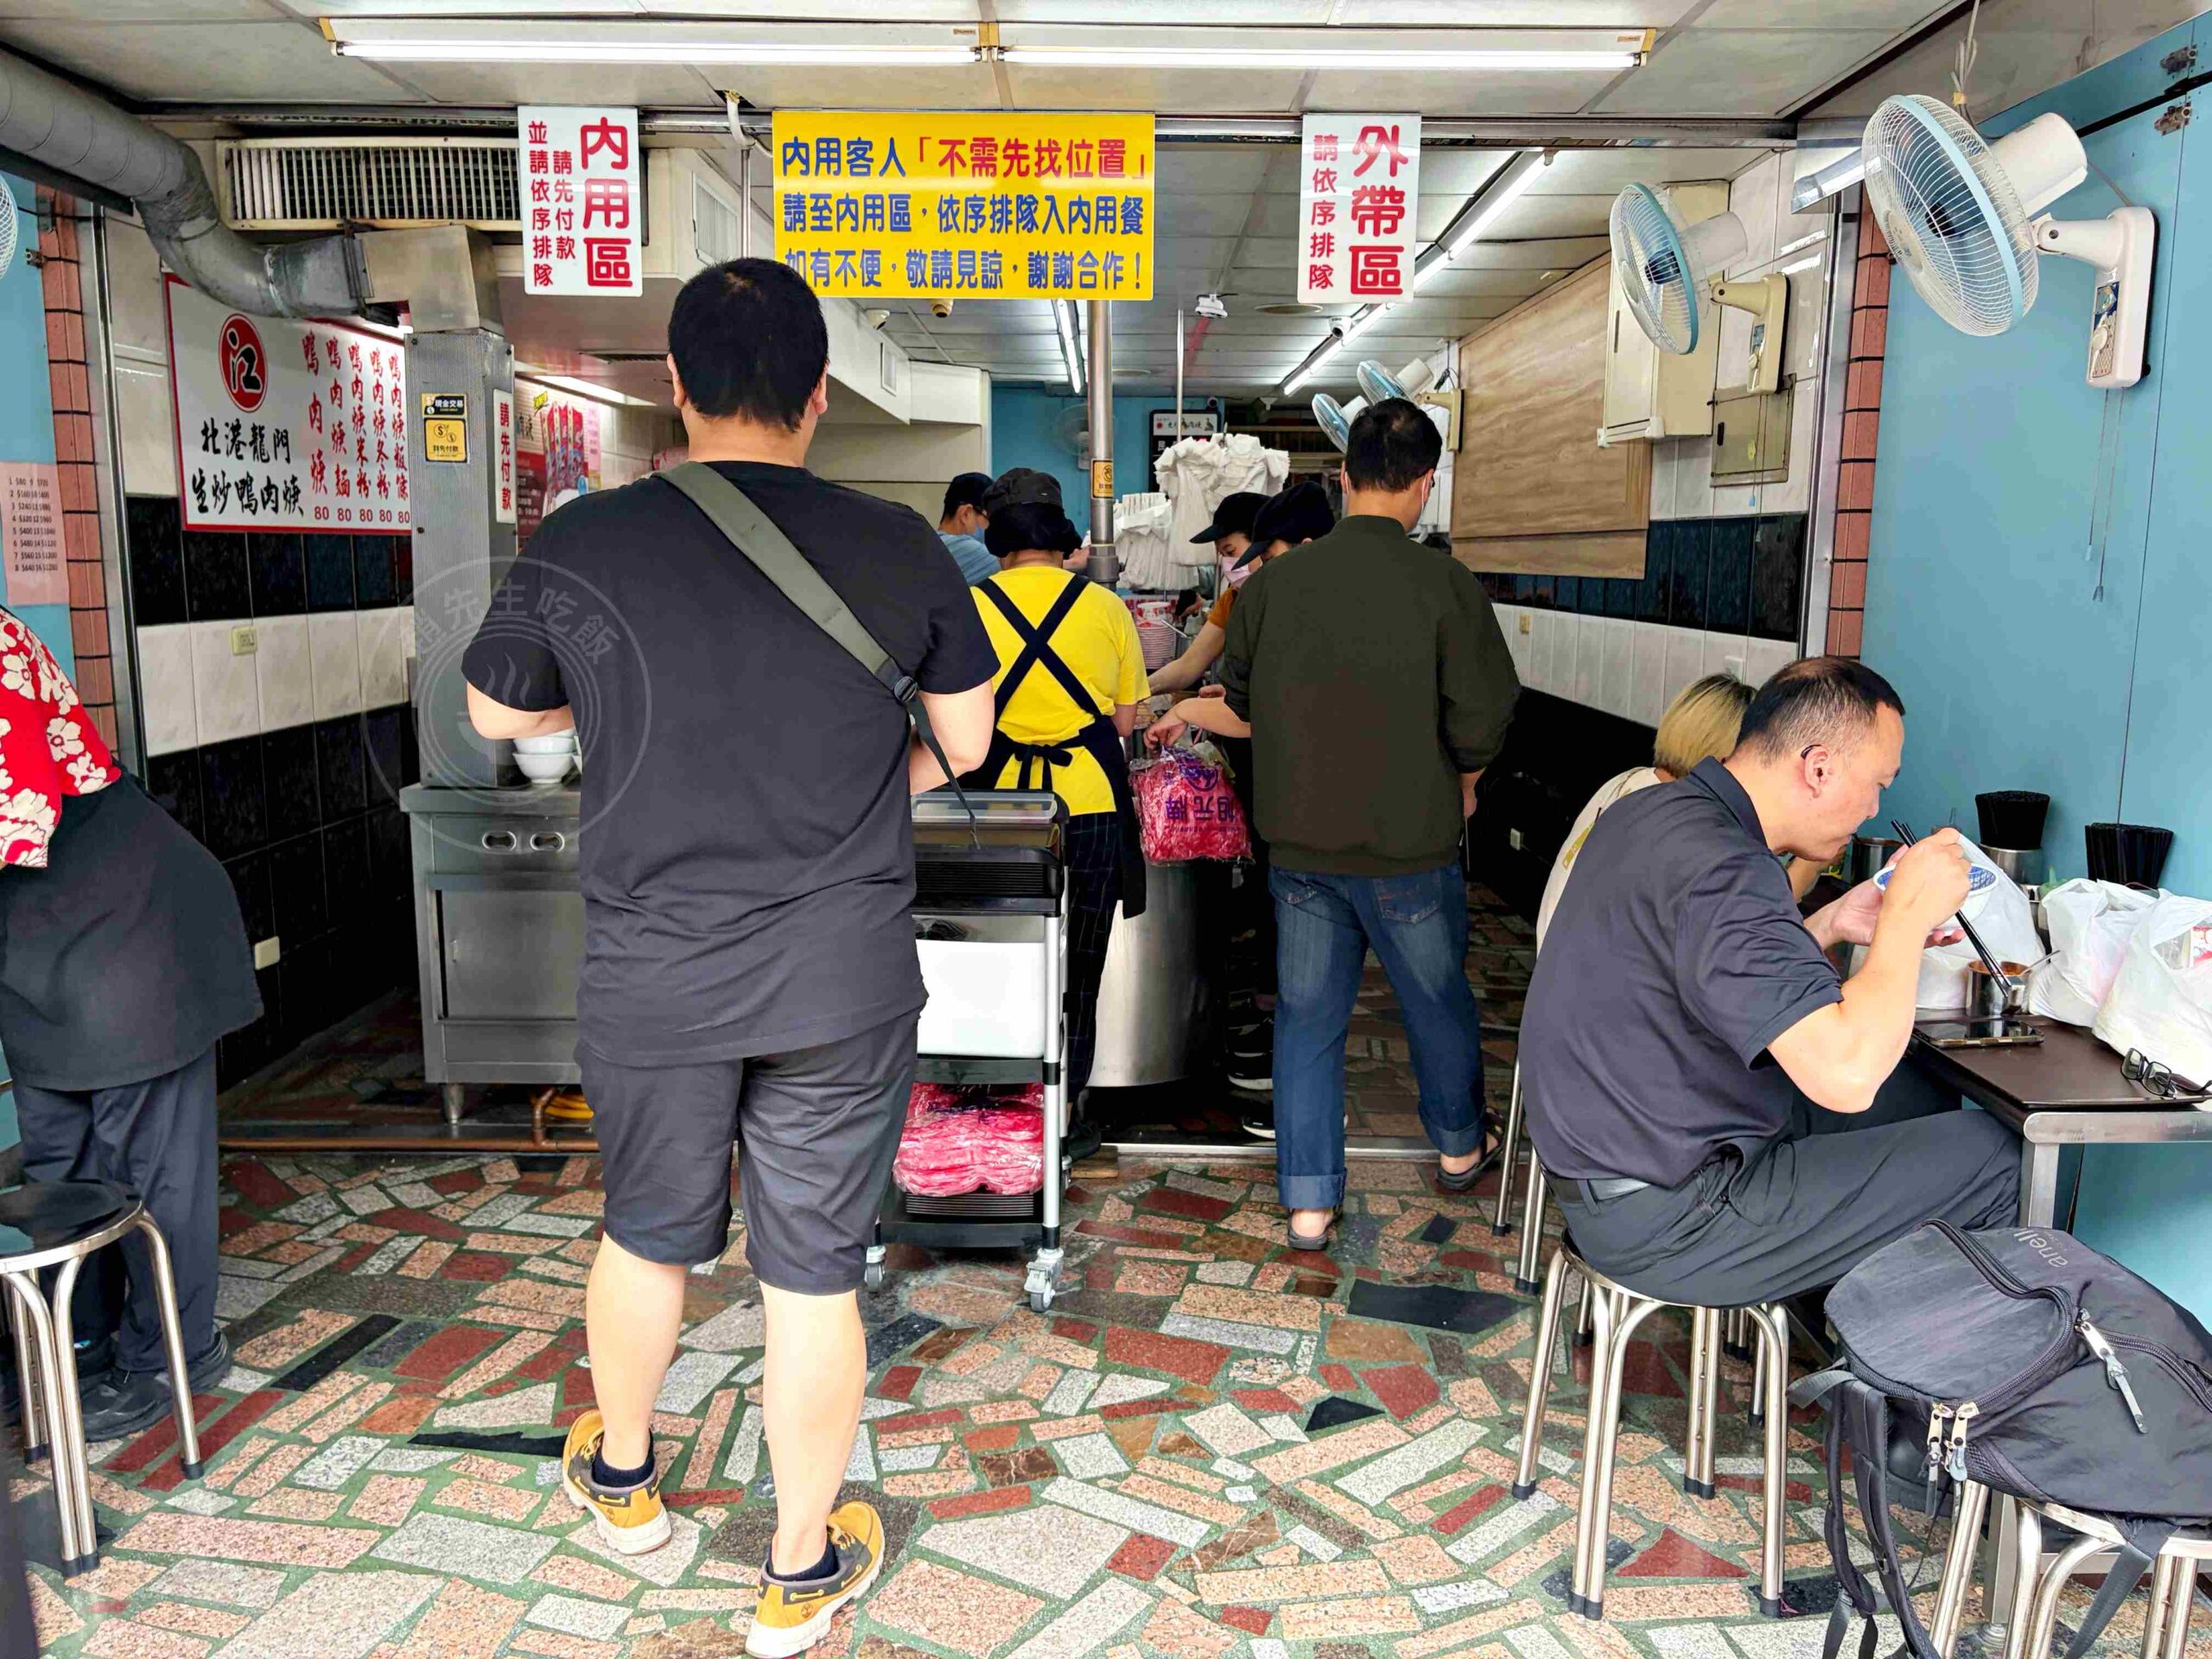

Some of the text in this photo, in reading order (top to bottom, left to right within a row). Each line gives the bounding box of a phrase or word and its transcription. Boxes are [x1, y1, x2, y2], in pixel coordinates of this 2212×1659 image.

[528, 120, 553, 287] 並請依序排隊
[553, 150, 575, 260] 請先付款
[580, 117, 632, 288] 內用區
[1308, 134, 1338, 290] 請依序排隊
[1348, 124, 1409, 296] 外帶區
[200, 416, 291, 465] 北港龍門
[499, 402, 512, 512] 請先付款
[314, 506, 329, 520] 80
[337, 507, 352, 522] 80
[359, 508, 373, 523] 80
[379, 509, 392, 523] 80
[397, 511, 410, 524] 80
[2013, 1228, 2069, 1268] anell
